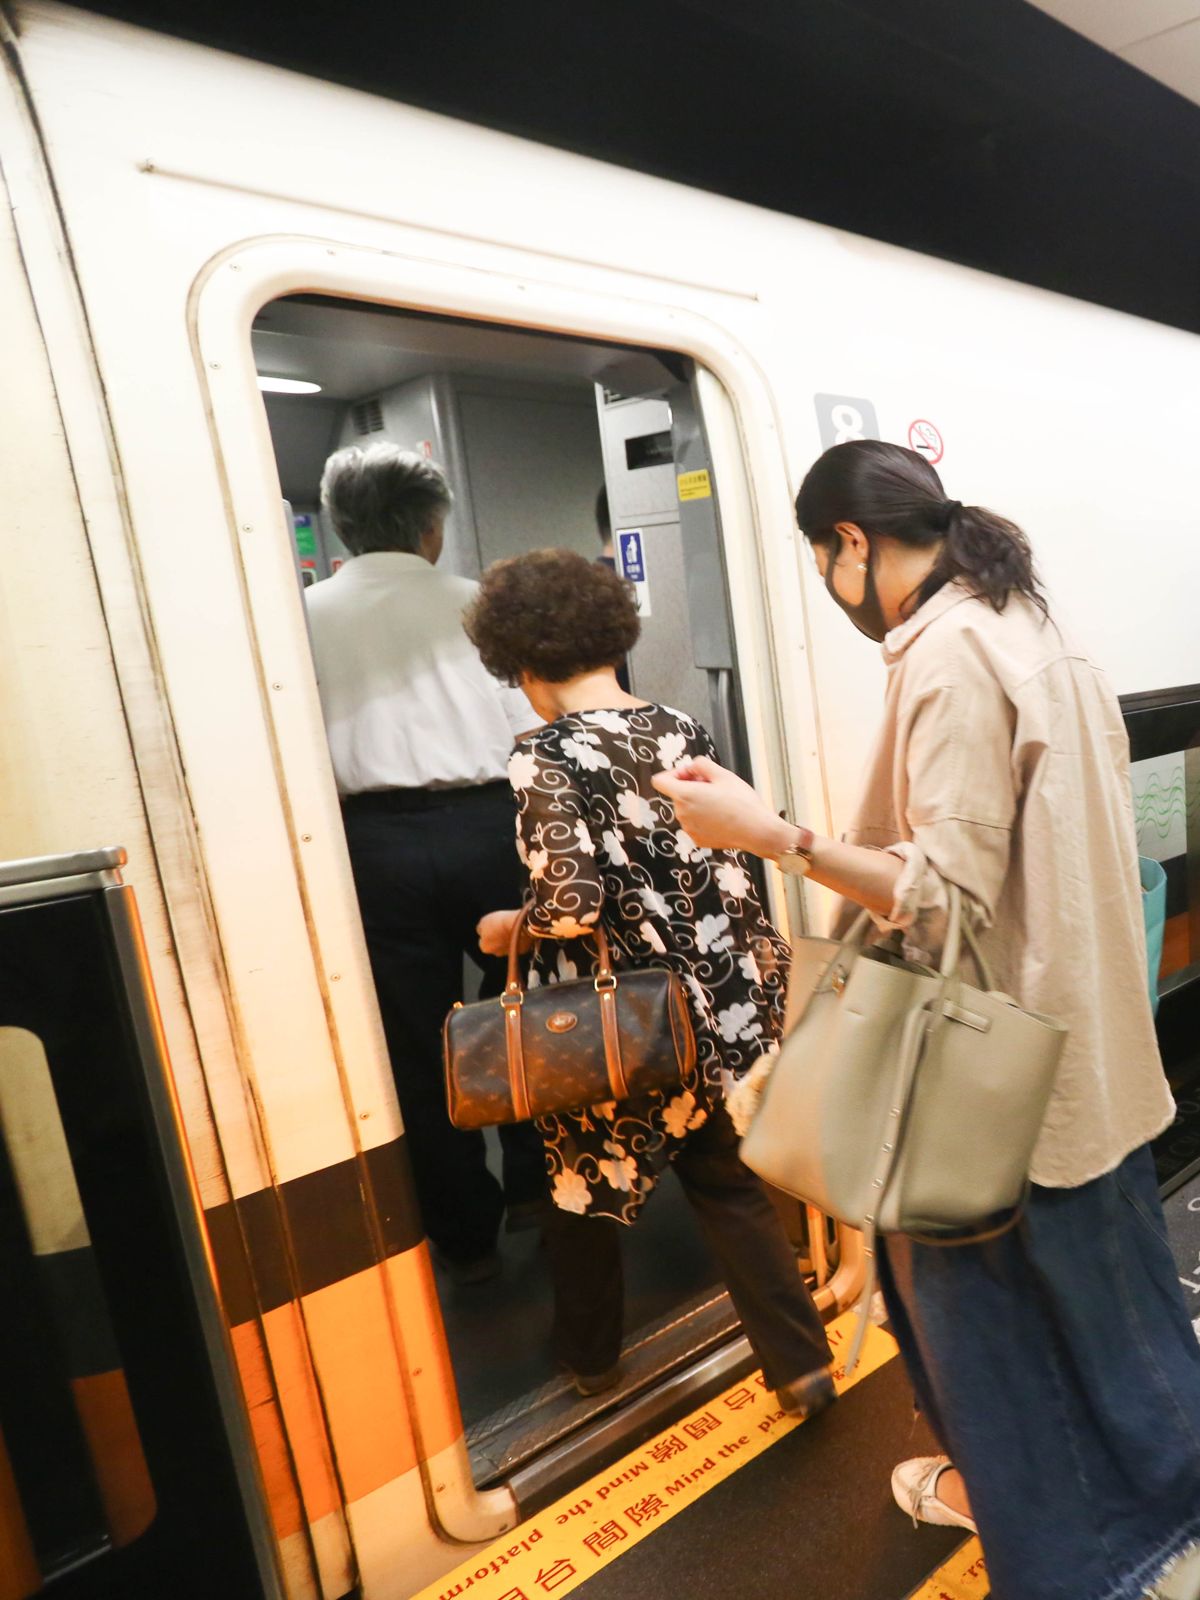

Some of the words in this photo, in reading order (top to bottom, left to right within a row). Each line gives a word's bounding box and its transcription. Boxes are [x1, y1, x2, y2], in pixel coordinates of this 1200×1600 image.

[596, 1461, 650, 1501] Mind
[664, 1457, 717, 1497] Mind
[718, 1433, 751, 1459] the
[555, 1498, 593, 1526] the
